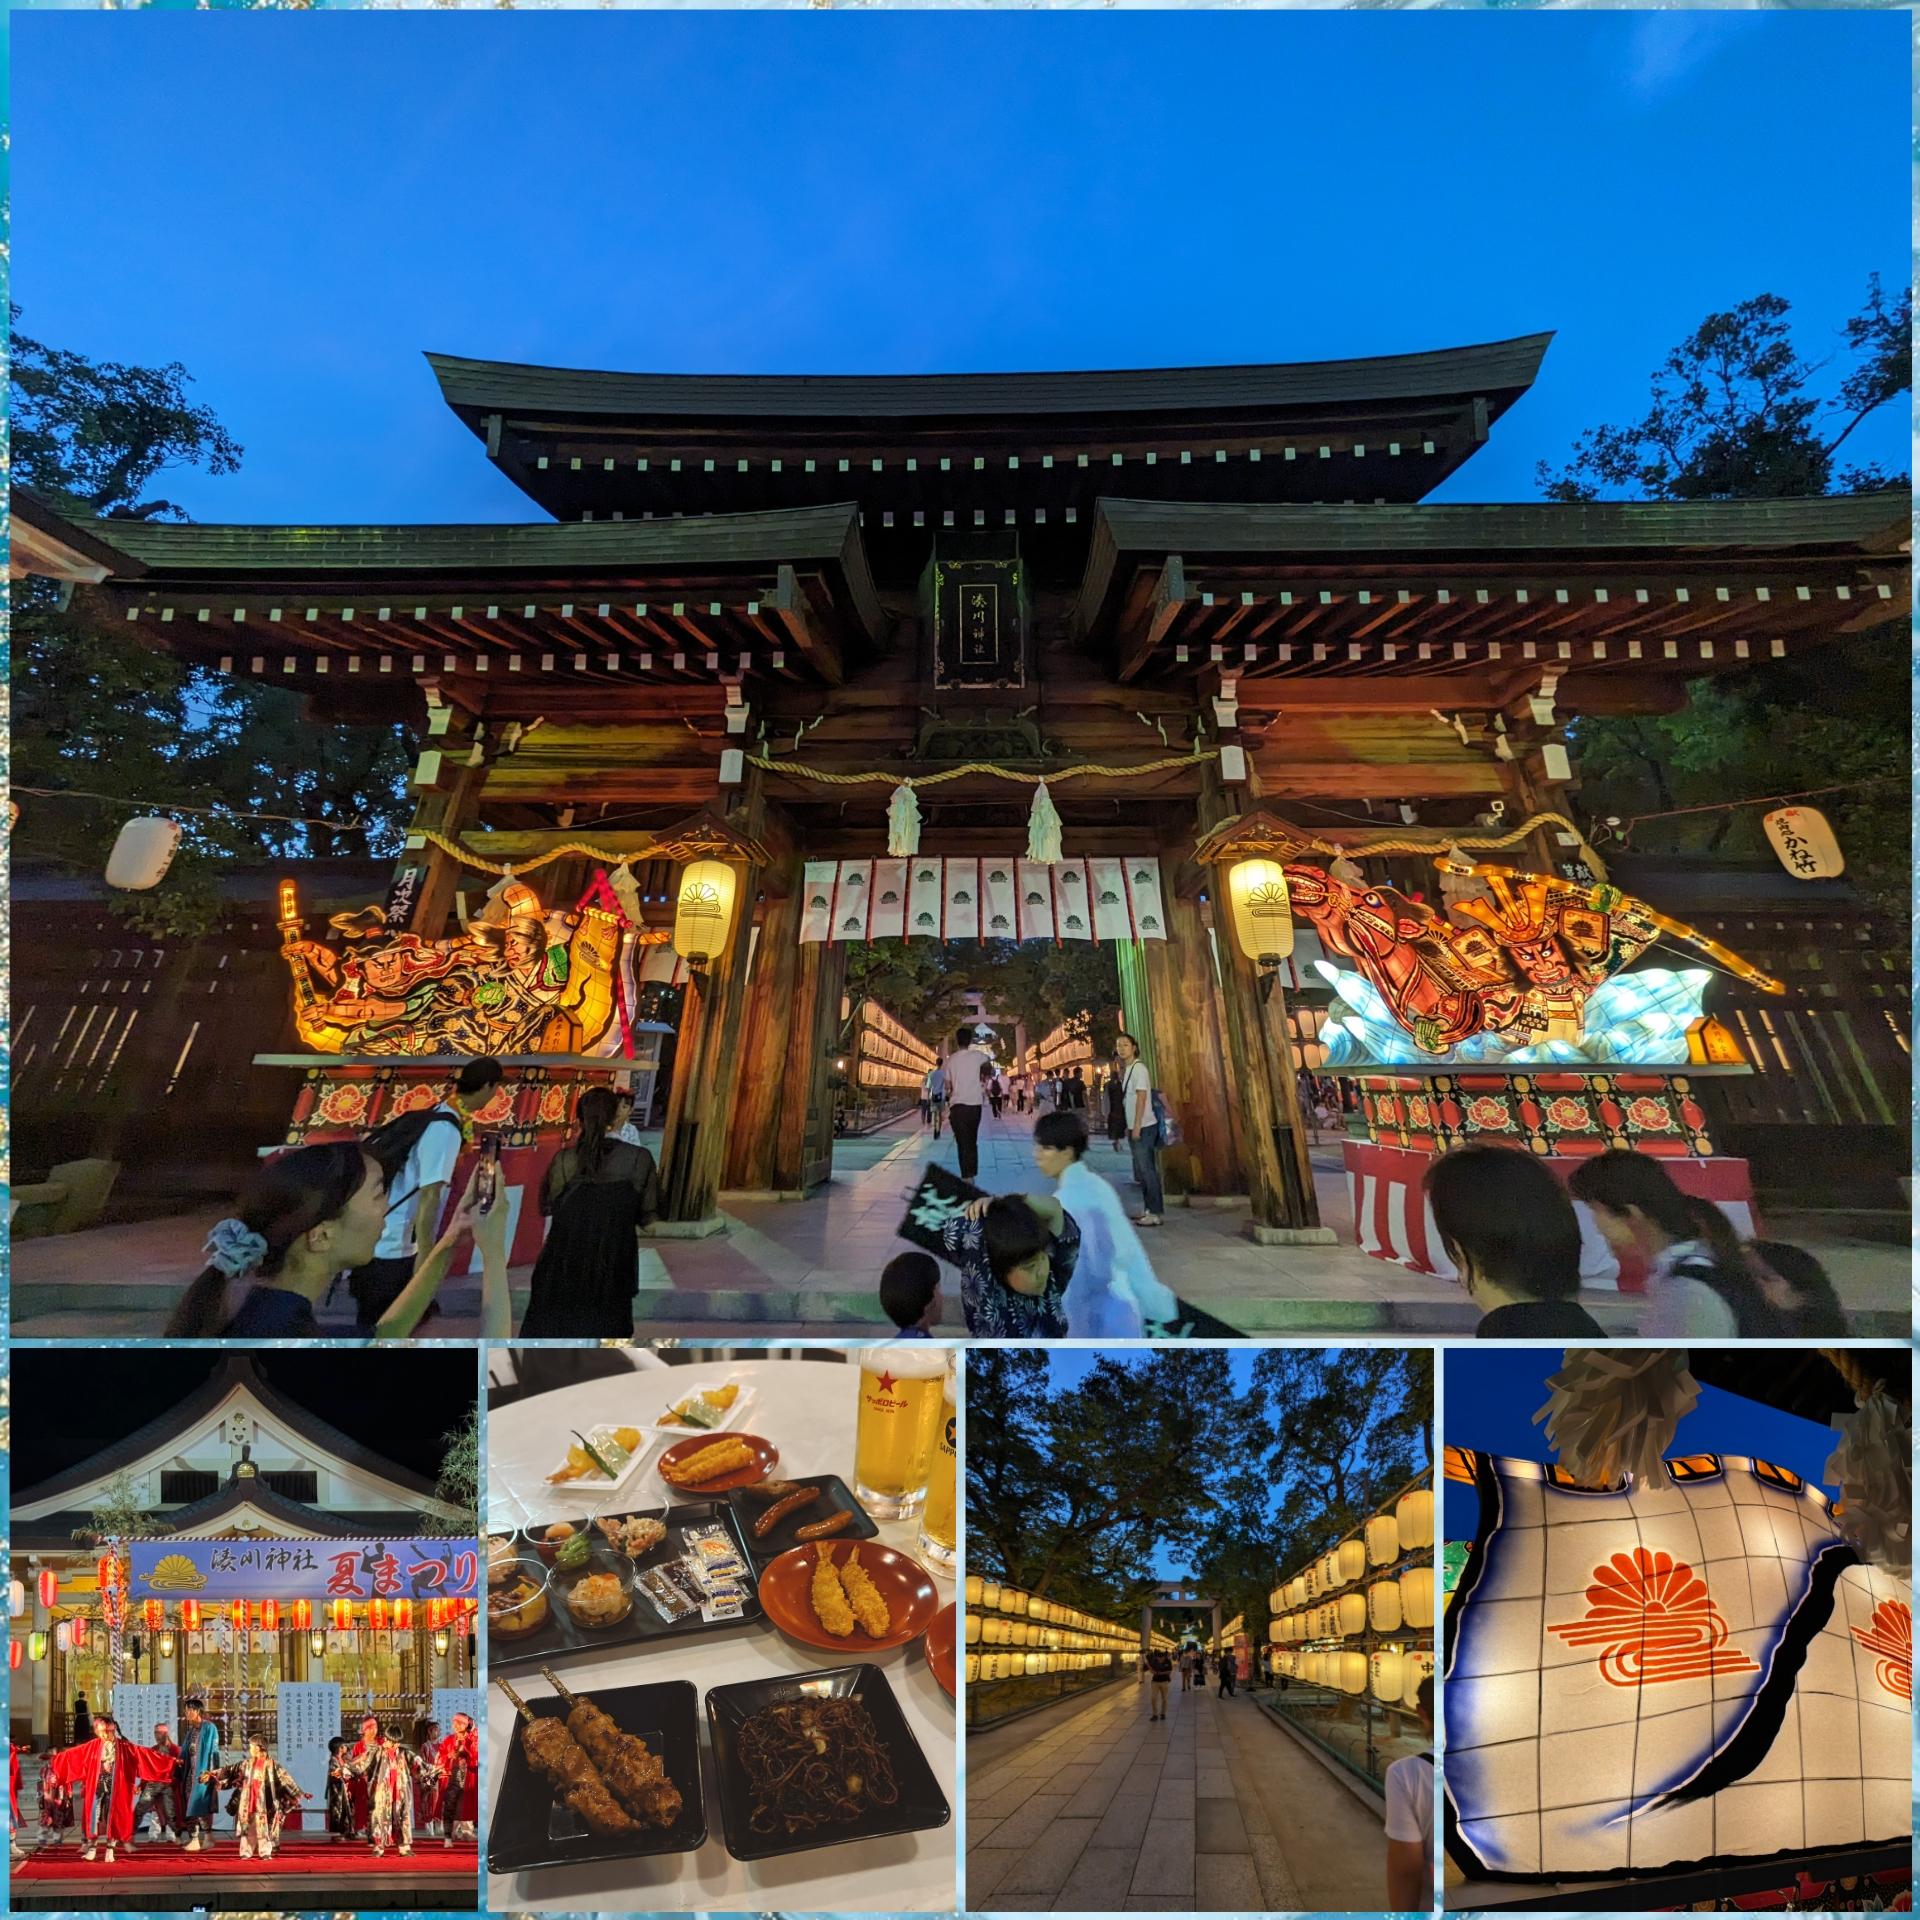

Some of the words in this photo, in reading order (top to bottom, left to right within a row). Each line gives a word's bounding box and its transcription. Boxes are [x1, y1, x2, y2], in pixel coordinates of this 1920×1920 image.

[971, 593, 988, 654] 湊川神社
[387, 868, 418, 923] 月次祭
[866, 1395, 909, 1408] サッポロビール
[940, 1442, 957, 1458] SAPP
[211, 1548, 319, 1572] 湊川神社
[327, 1551, 478, 1596] 夏まつり
